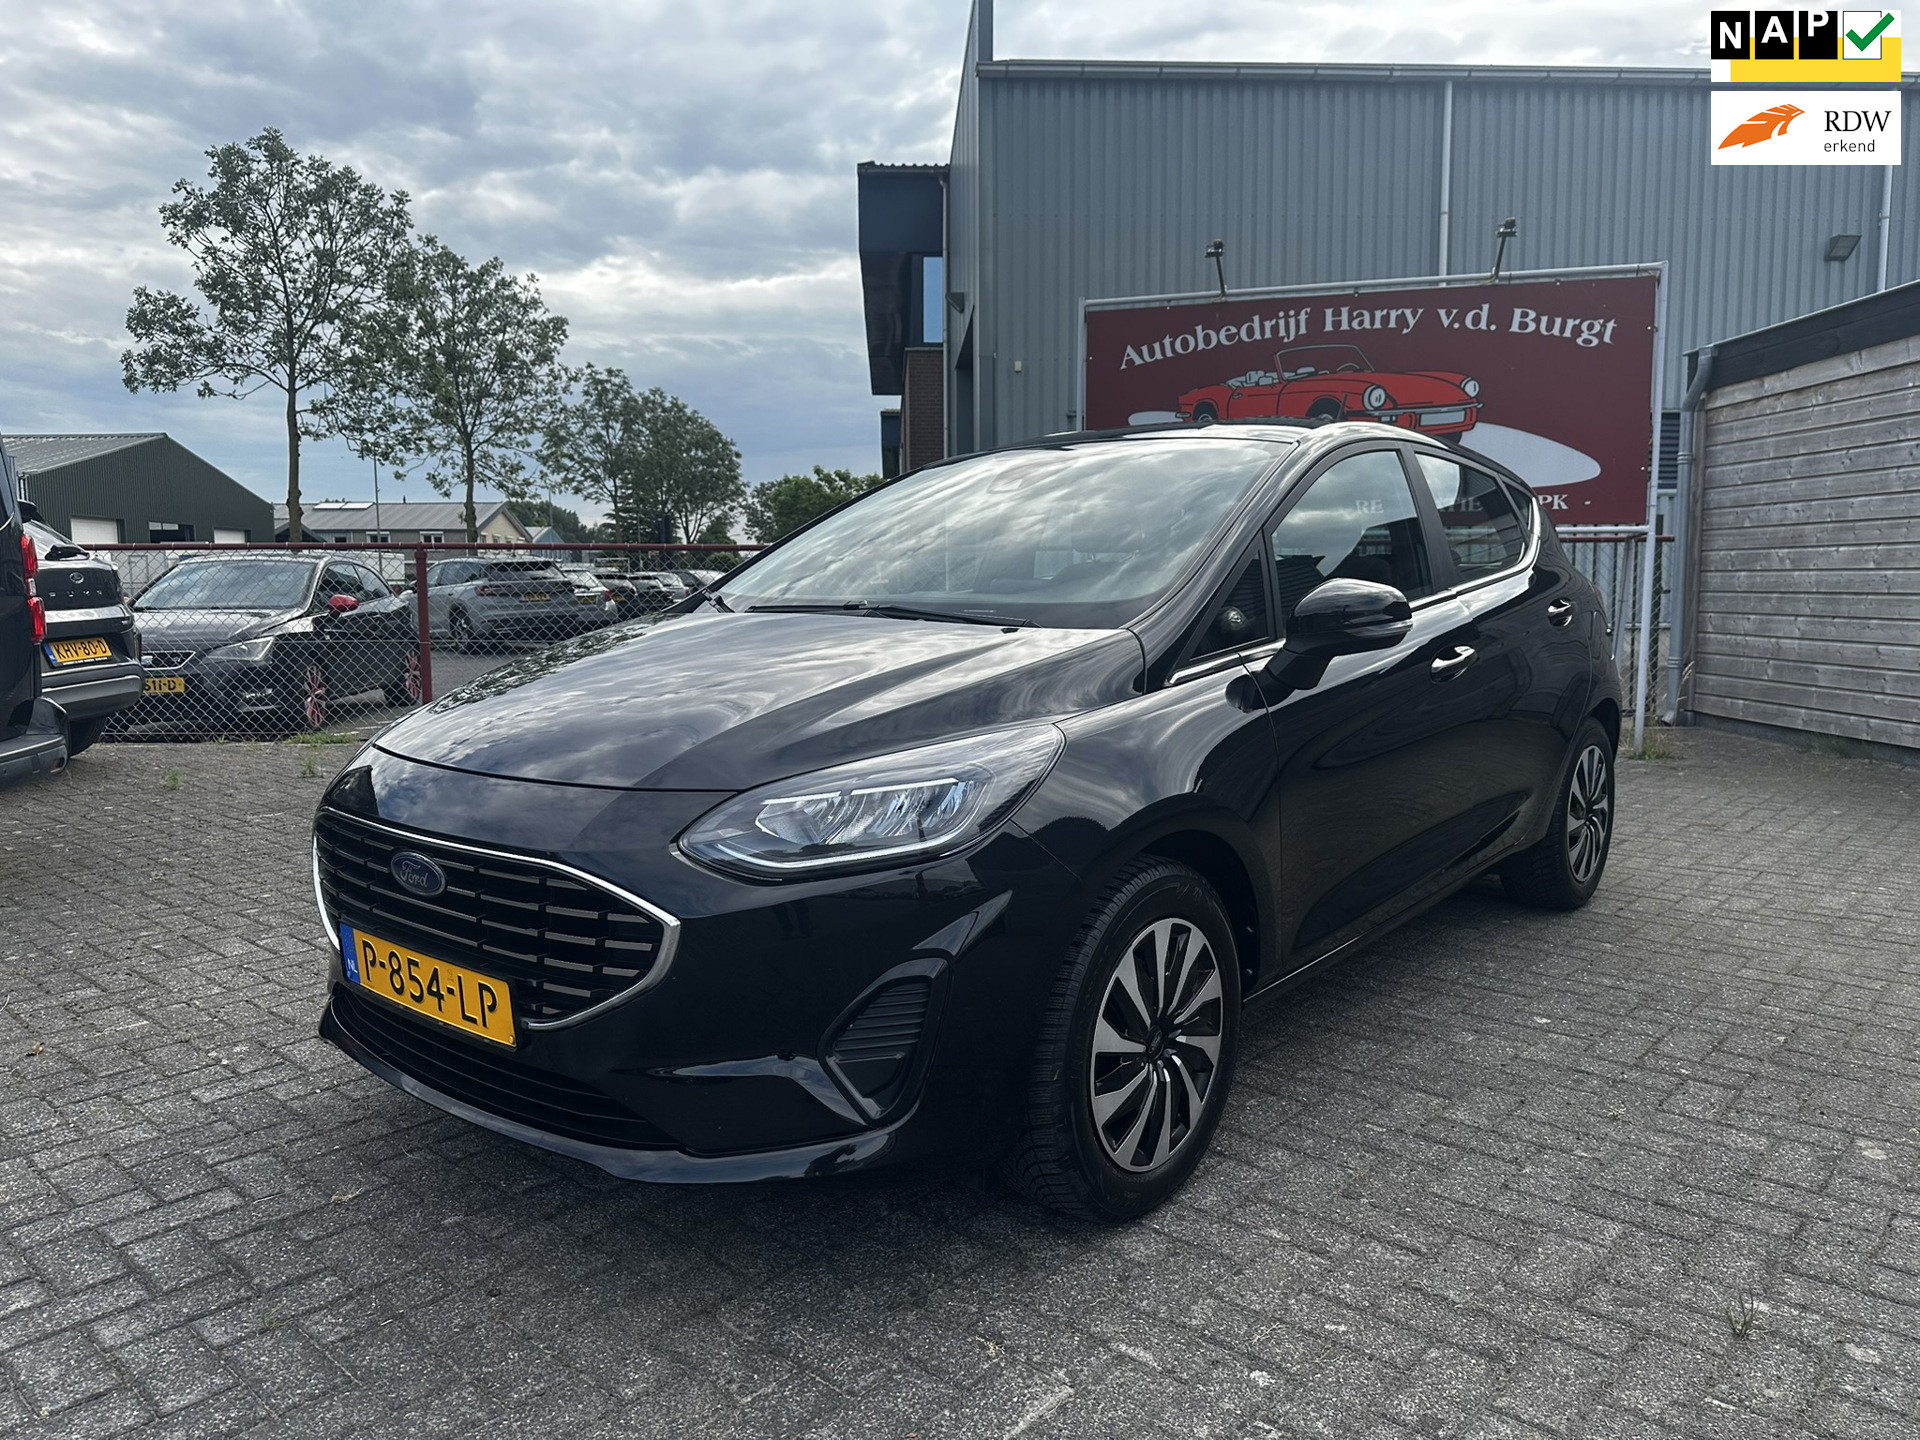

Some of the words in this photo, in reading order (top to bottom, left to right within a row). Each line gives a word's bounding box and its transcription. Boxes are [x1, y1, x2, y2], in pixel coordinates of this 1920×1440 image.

[1120, 307, 1311, 370] Autobedrijf
[1323, 306, 1424, 335] Harry
[1437, 303, 1497, 331] v.d.
[1509, 307, 1617, 347] Burgt
[1537, 494, 1569, 510] PK
[53, 640, 107, 659] KHV-80-D
[401, 860, 430, 888] Ford
[361, 938, 498, 1028] P-854-LP
